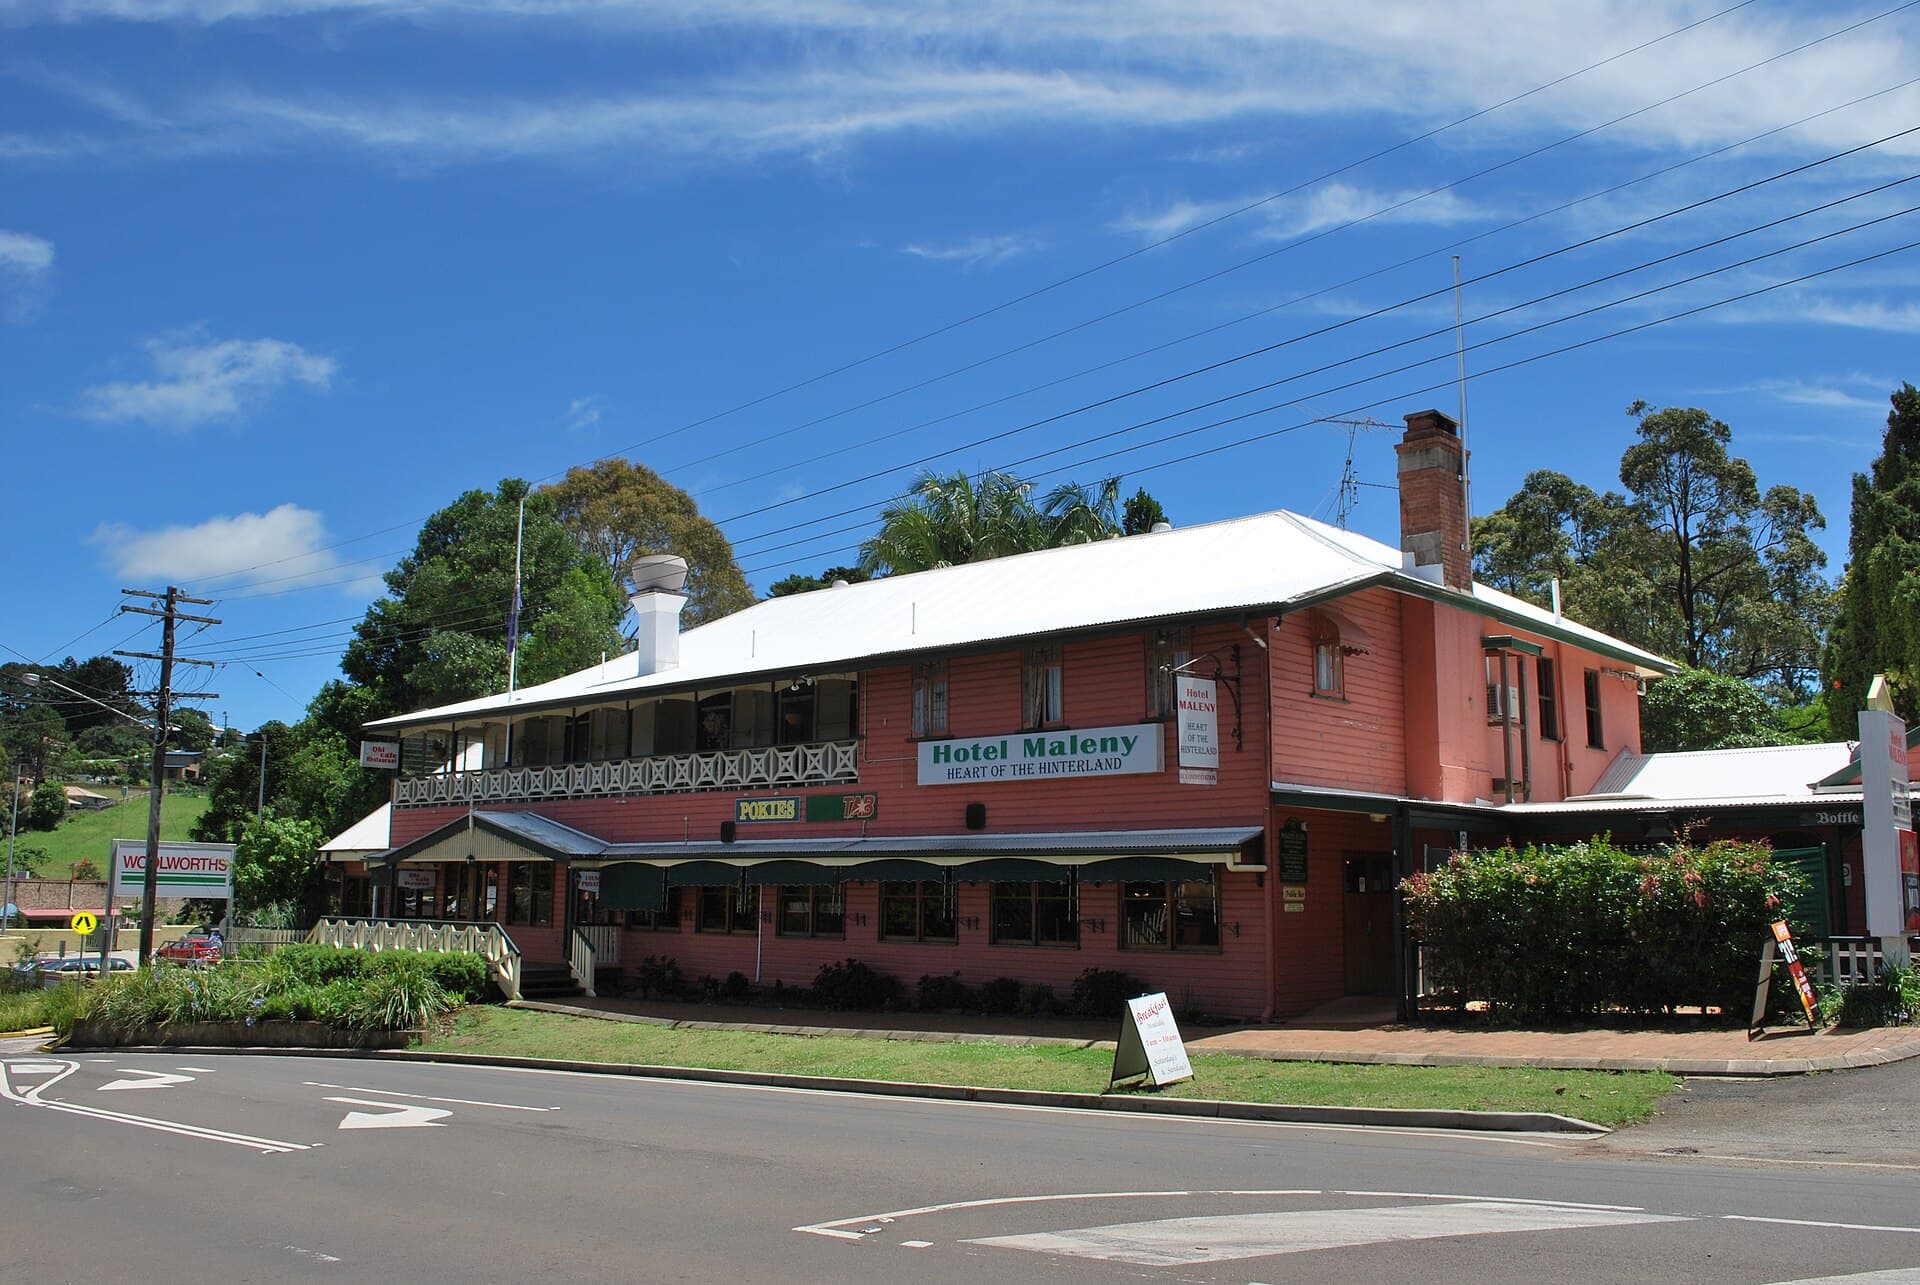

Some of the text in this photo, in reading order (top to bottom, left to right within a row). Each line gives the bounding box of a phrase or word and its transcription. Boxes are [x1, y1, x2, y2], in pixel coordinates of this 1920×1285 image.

[1186, 688, 1209, 699] Hotel
[1179, 700, 1216, 713] MALENY
[1187, 722, 1208, 732] HEART
[1187, 734, 1209, 744] OF THE
[933, 734, 1139, 764] Hotel Maleny
[1180, 745, 1217, 756] HINTERLAND
[947, 757, 1122, 780] HEART OF THE HINTERLAND
[739, 800, 795, 820] POKIES
[843, 795, 876, 819] TAB
[1815, 811, 1859, 824] Bottle
[1136, 999, 1168, 1025] Breakfast
